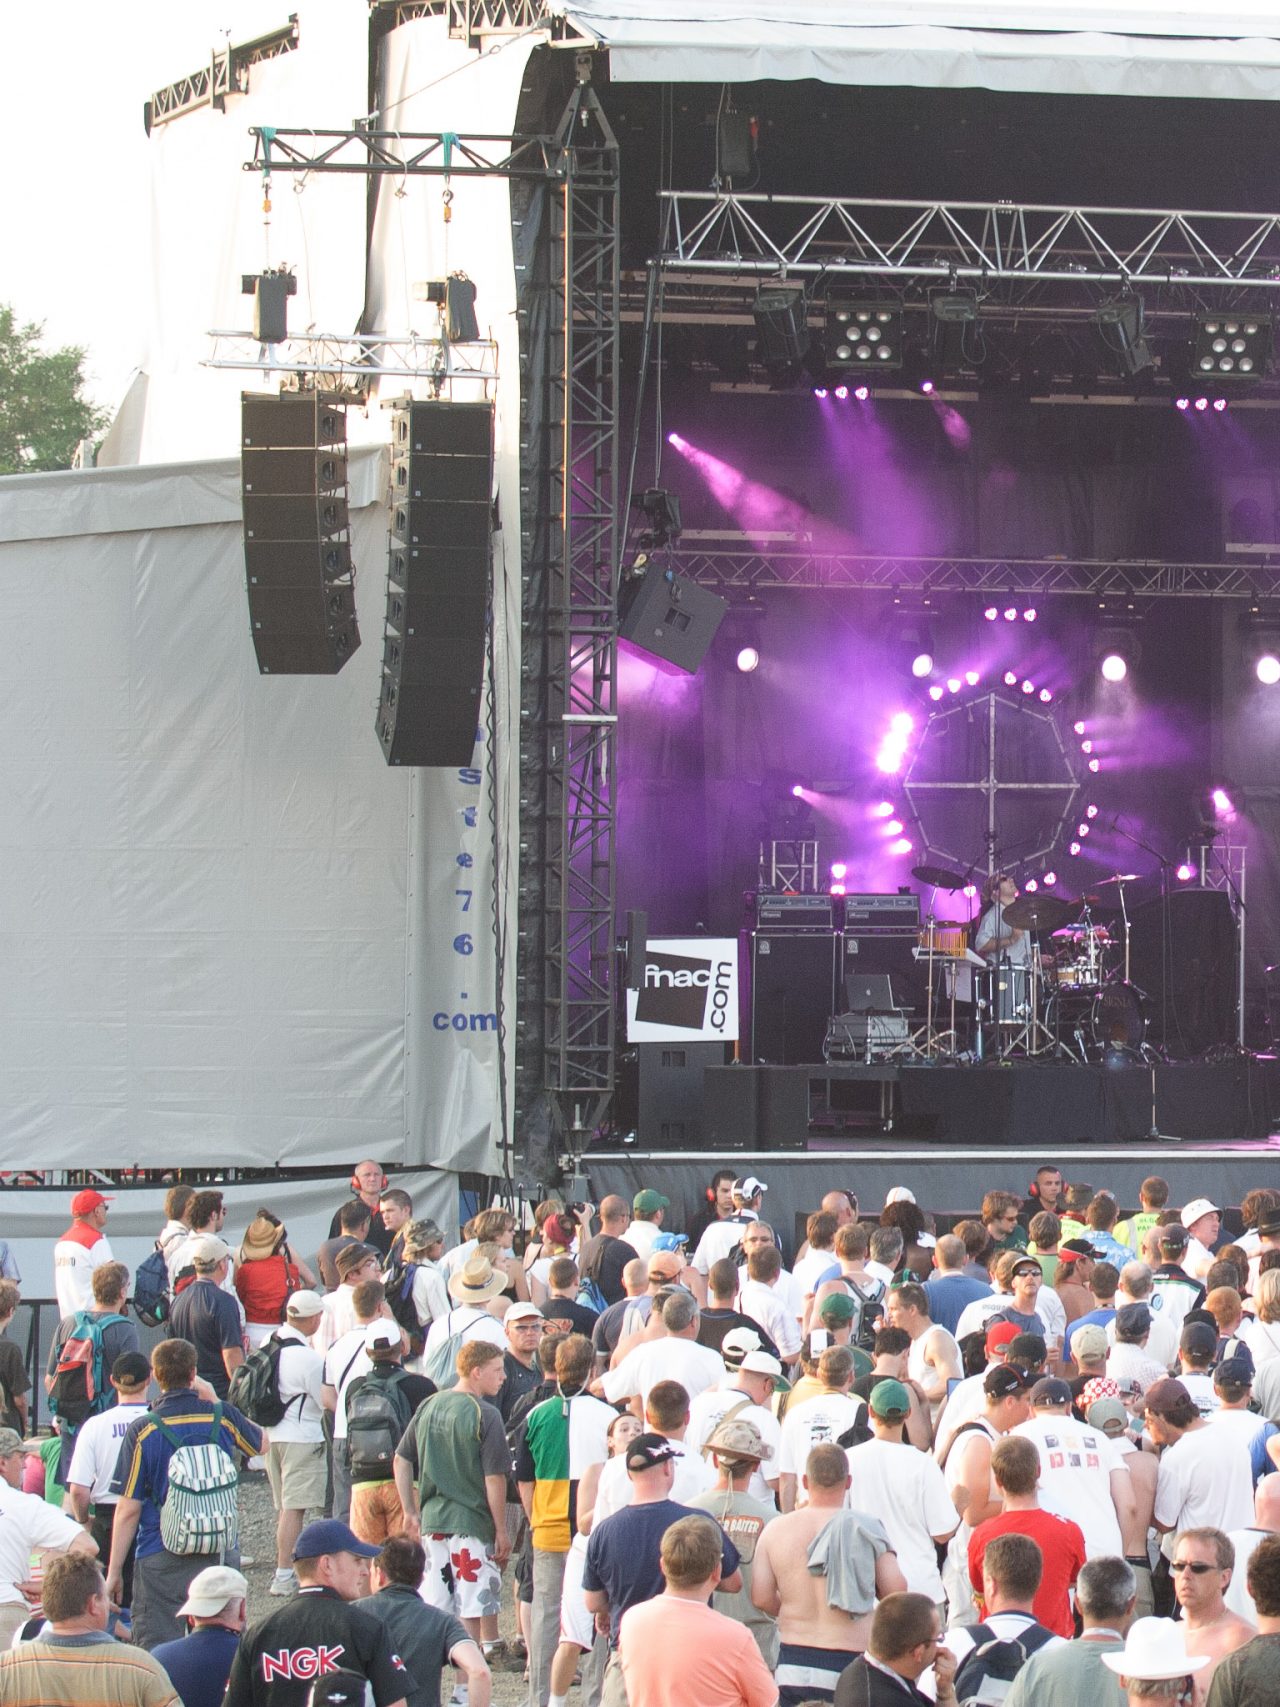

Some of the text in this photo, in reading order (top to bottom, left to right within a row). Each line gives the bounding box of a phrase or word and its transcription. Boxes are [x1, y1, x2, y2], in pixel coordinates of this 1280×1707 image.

[645, 964, 711, 988] fnac
[711, 961, 733, 1033] .com
[262, 1644, 345, 1682] NGK
